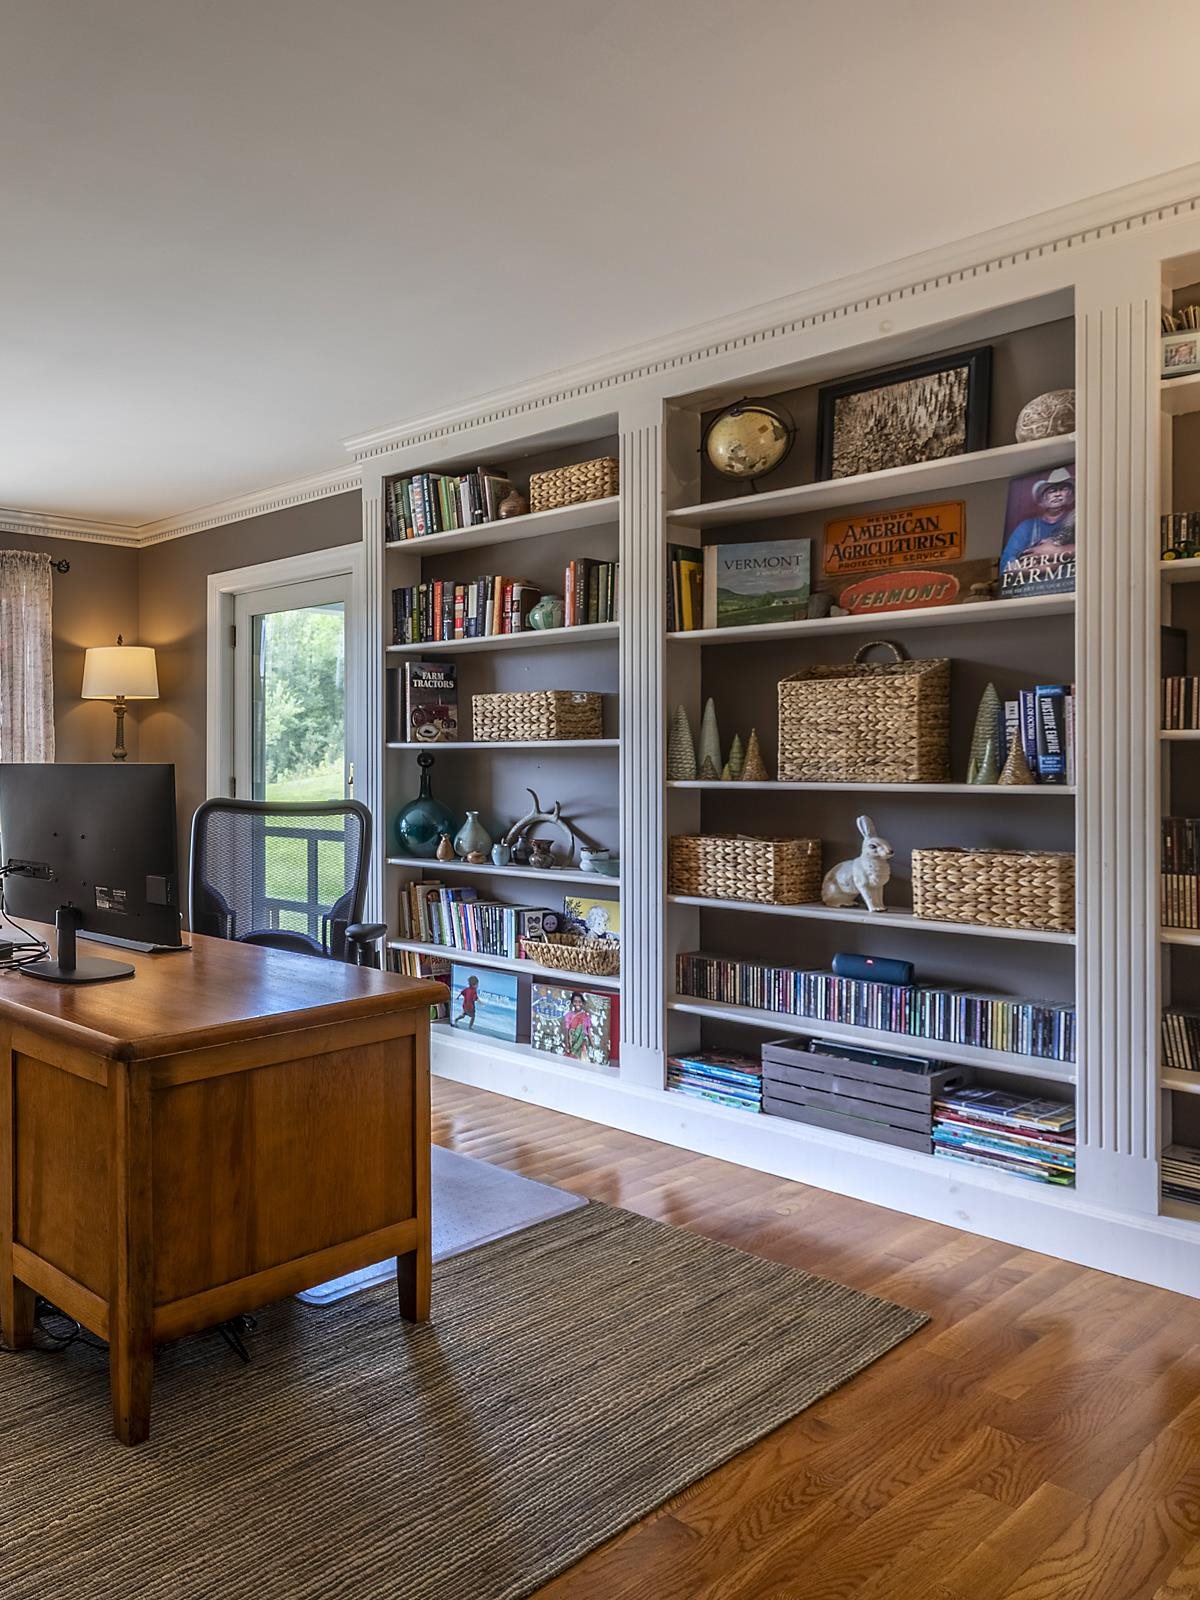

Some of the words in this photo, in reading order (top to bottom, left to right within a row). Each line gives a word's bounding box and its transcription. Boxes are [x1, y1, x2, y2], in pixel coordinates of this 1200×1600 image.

[867, 512, 913, 523] MEMBER
[841, 515, 941, 545] AMERICAN
[827, 531, 958, 563] AGRICULTURIST
[724, 554, 803, 570] VERMONT
[838, 556, 894, 570] PROTECTIVE
[903, 550, 946, 562] SERVICE
[1003, 550, 1076, 573] AMERIC
[847, 582, 951, 610] VERMONT
[413, 680, 454, 688] TRACTORS
[422, 671, 445, 680] FARM
[1040, 697, 1057, 729] PINSTRIPE
[1044, 730, 1061, 753] EMPIRE
